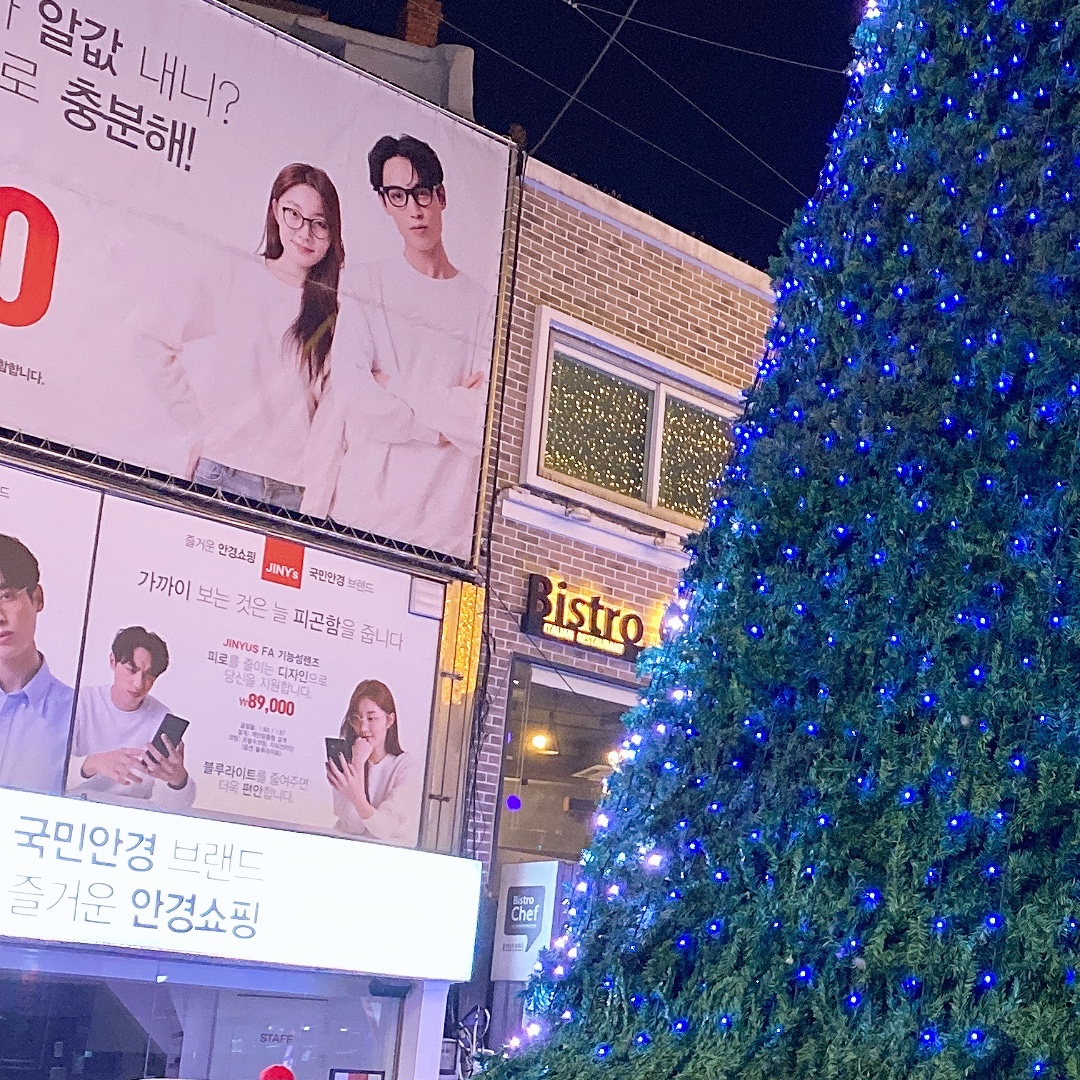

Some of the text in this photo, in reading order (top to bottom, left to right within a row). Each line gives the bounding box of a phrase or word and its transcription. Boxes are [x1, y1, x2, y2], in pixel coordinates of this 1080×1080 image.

[38, 0, 240, 125] 알값 내니?
[60, 77, 197, 172] 충분해!
[185, 534, 257, 564] 즐거운 안경쇼핑
[309, 567, 374, 593] 국민안경 브랜드
[138, 571, 403, 651] 가까이 보는 것은 늘 피곤함을 줍니다
[529, 573, 644, 645] Bistro
[207, 651, 239, 669] 피로를
[278, 666, 328, 686] 디자인으로
[223, 638, 320, 667] JINYUS FA 기능성렌즈
[203, 761, 267, 784] 블루라이트를
[14, 815, 263, 881] 국민안경 브랜드
[8, 874, 260, 939] 즐거운 안경쇼핑
[511, 904, 540, 922] Chef
[512, 895, 535, 905] Bistro
[259, 1033, 295, 1045] STAFF
